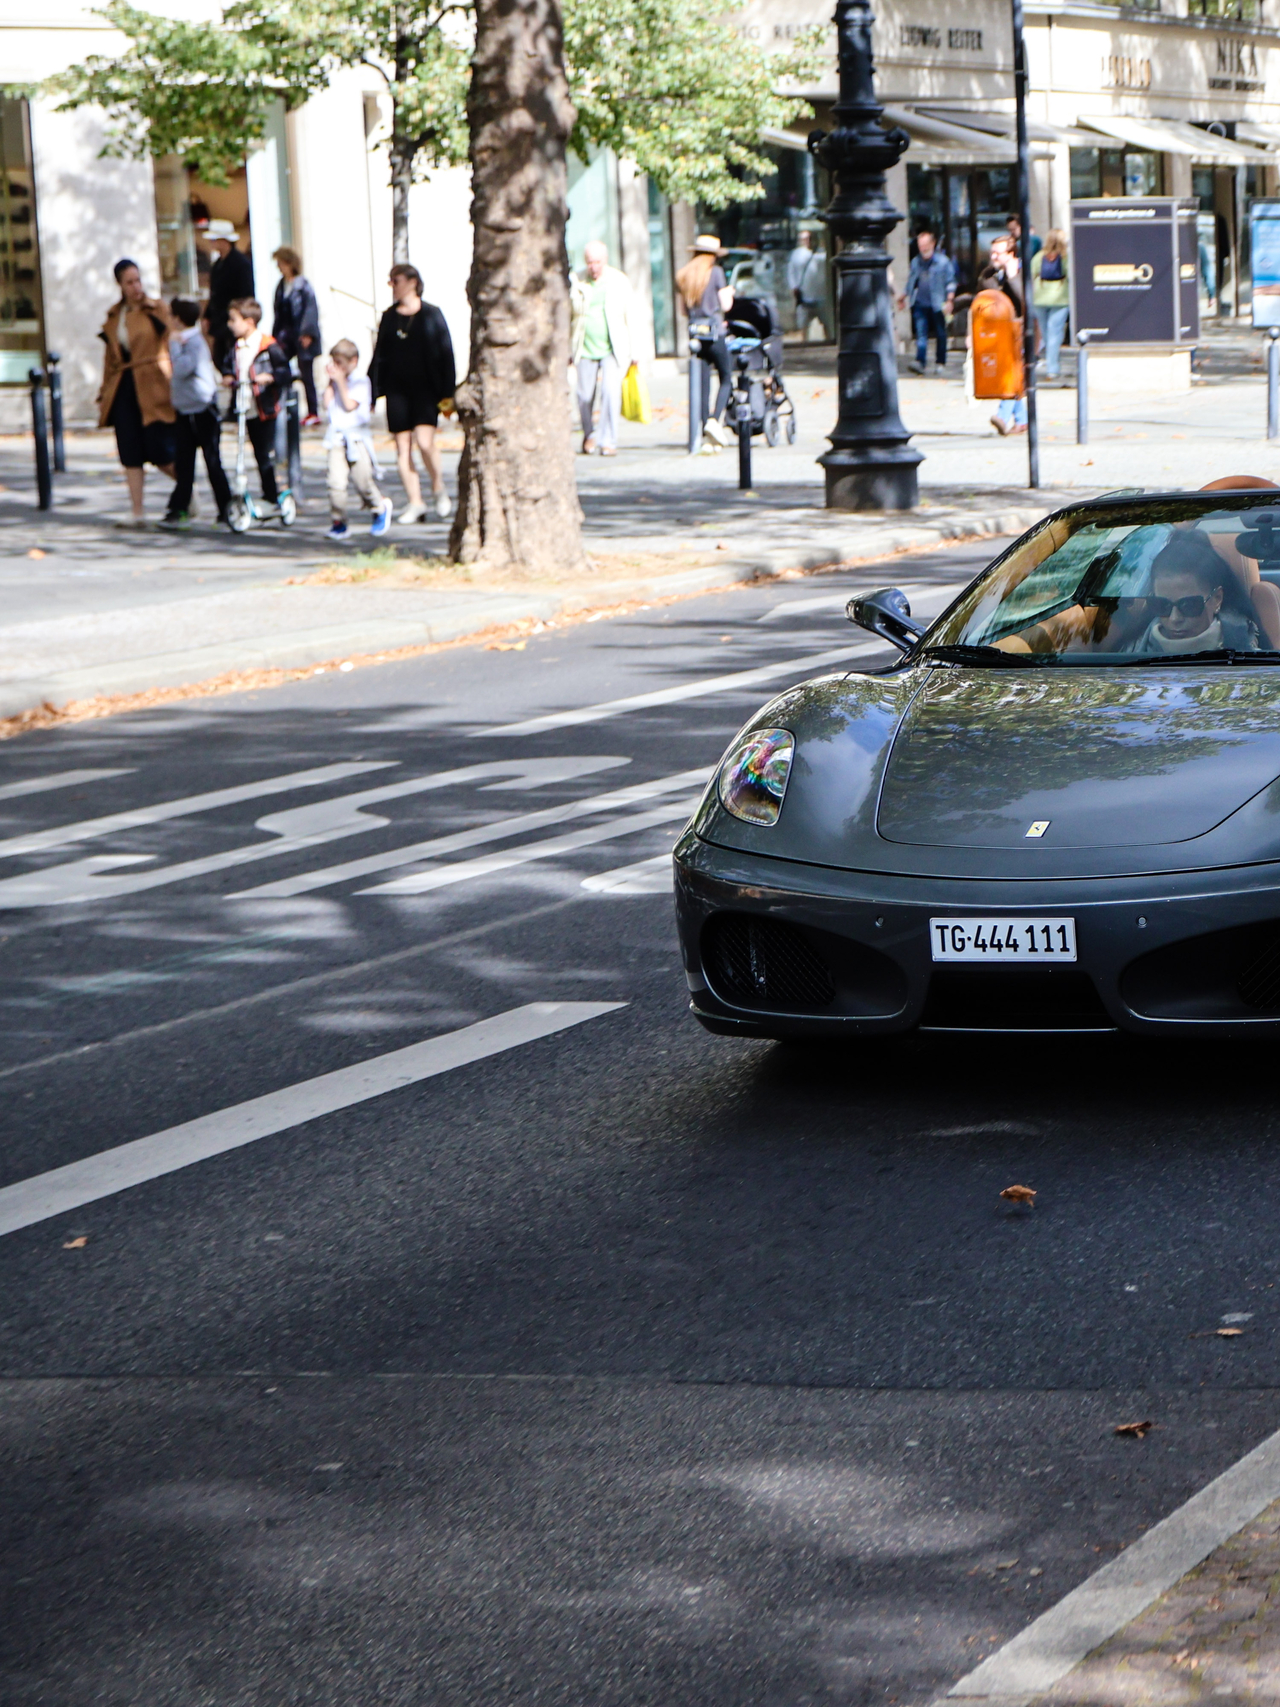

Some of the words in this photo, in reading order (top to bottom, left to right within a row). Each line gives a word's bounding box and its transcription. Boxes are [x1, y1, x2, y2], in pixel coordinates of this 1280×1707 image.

[899, 25, 942, 49] LUDWIG
[948, 28, 983, 51] REITER
[1216, 38, 1259, 77] NIKA
[1025, 924, 1071, 953] 111
